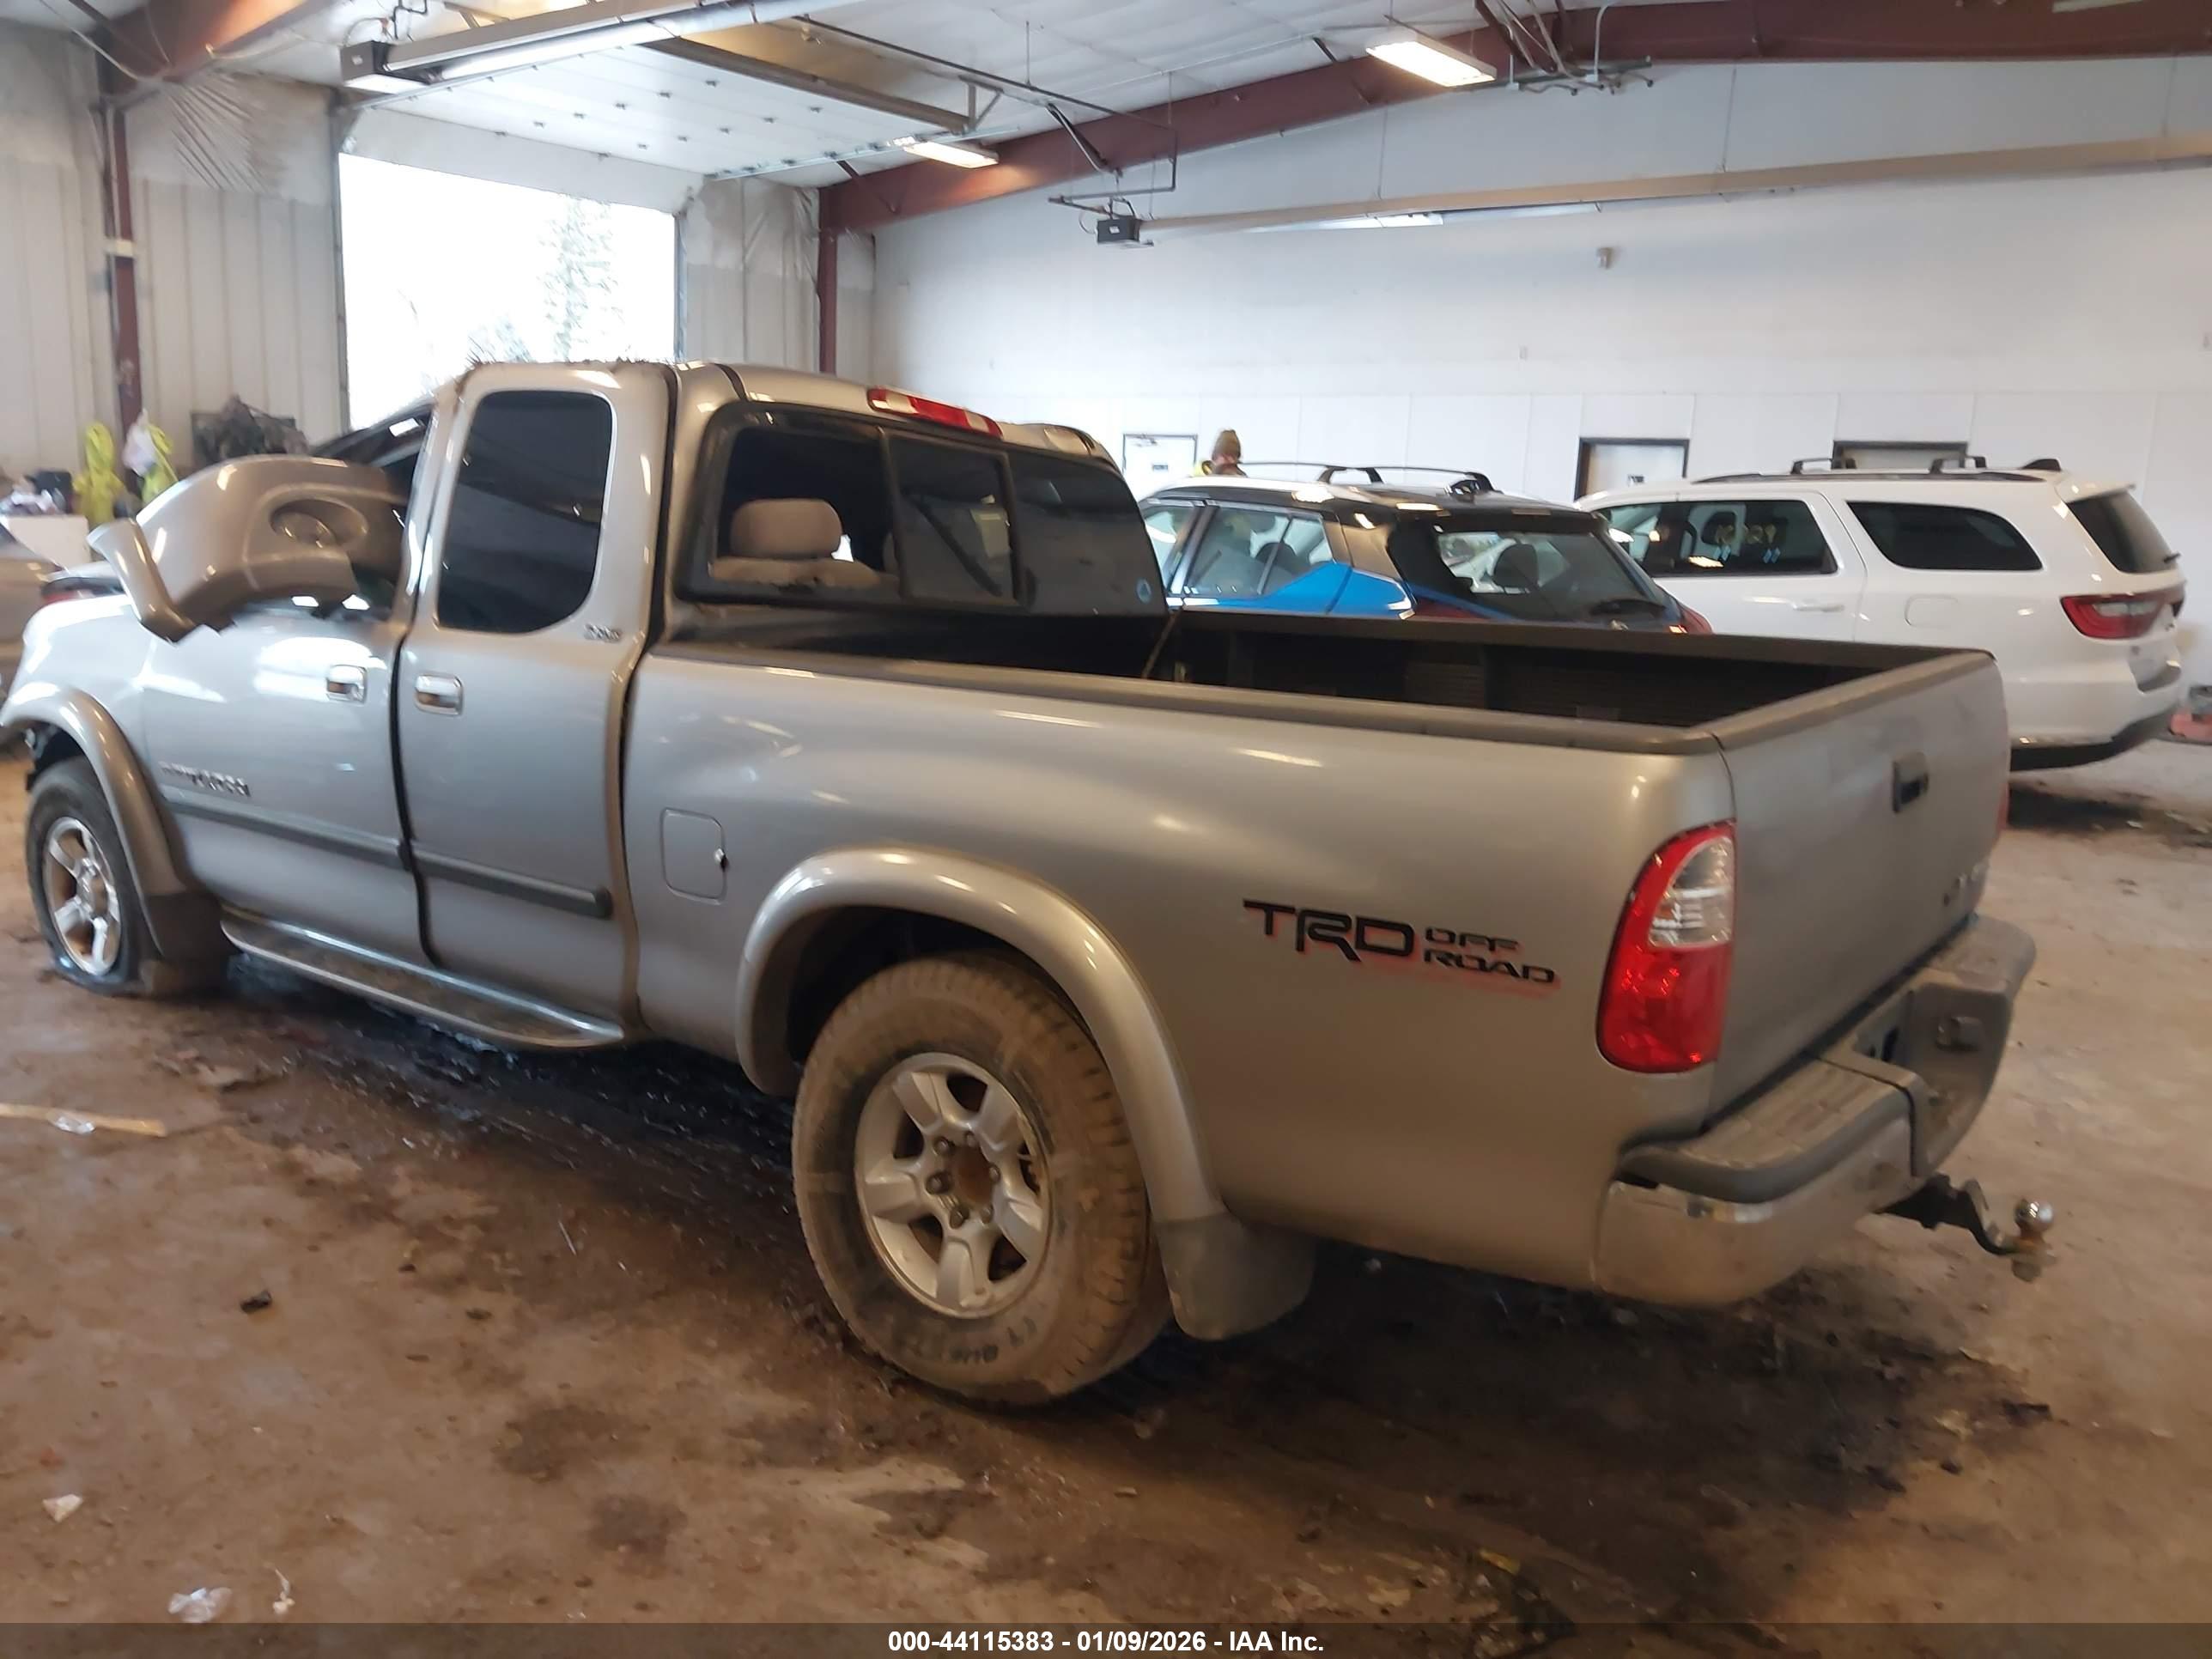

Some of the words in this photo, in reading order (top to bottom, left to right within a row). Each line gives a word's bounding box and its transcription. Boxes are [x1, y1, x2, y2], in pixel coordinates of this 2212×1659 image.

[1243, 898, 1415, 963] TRD
[1425, 927, 1519, 951] OFF
[1423, 948, 1555, 983] ROAD
